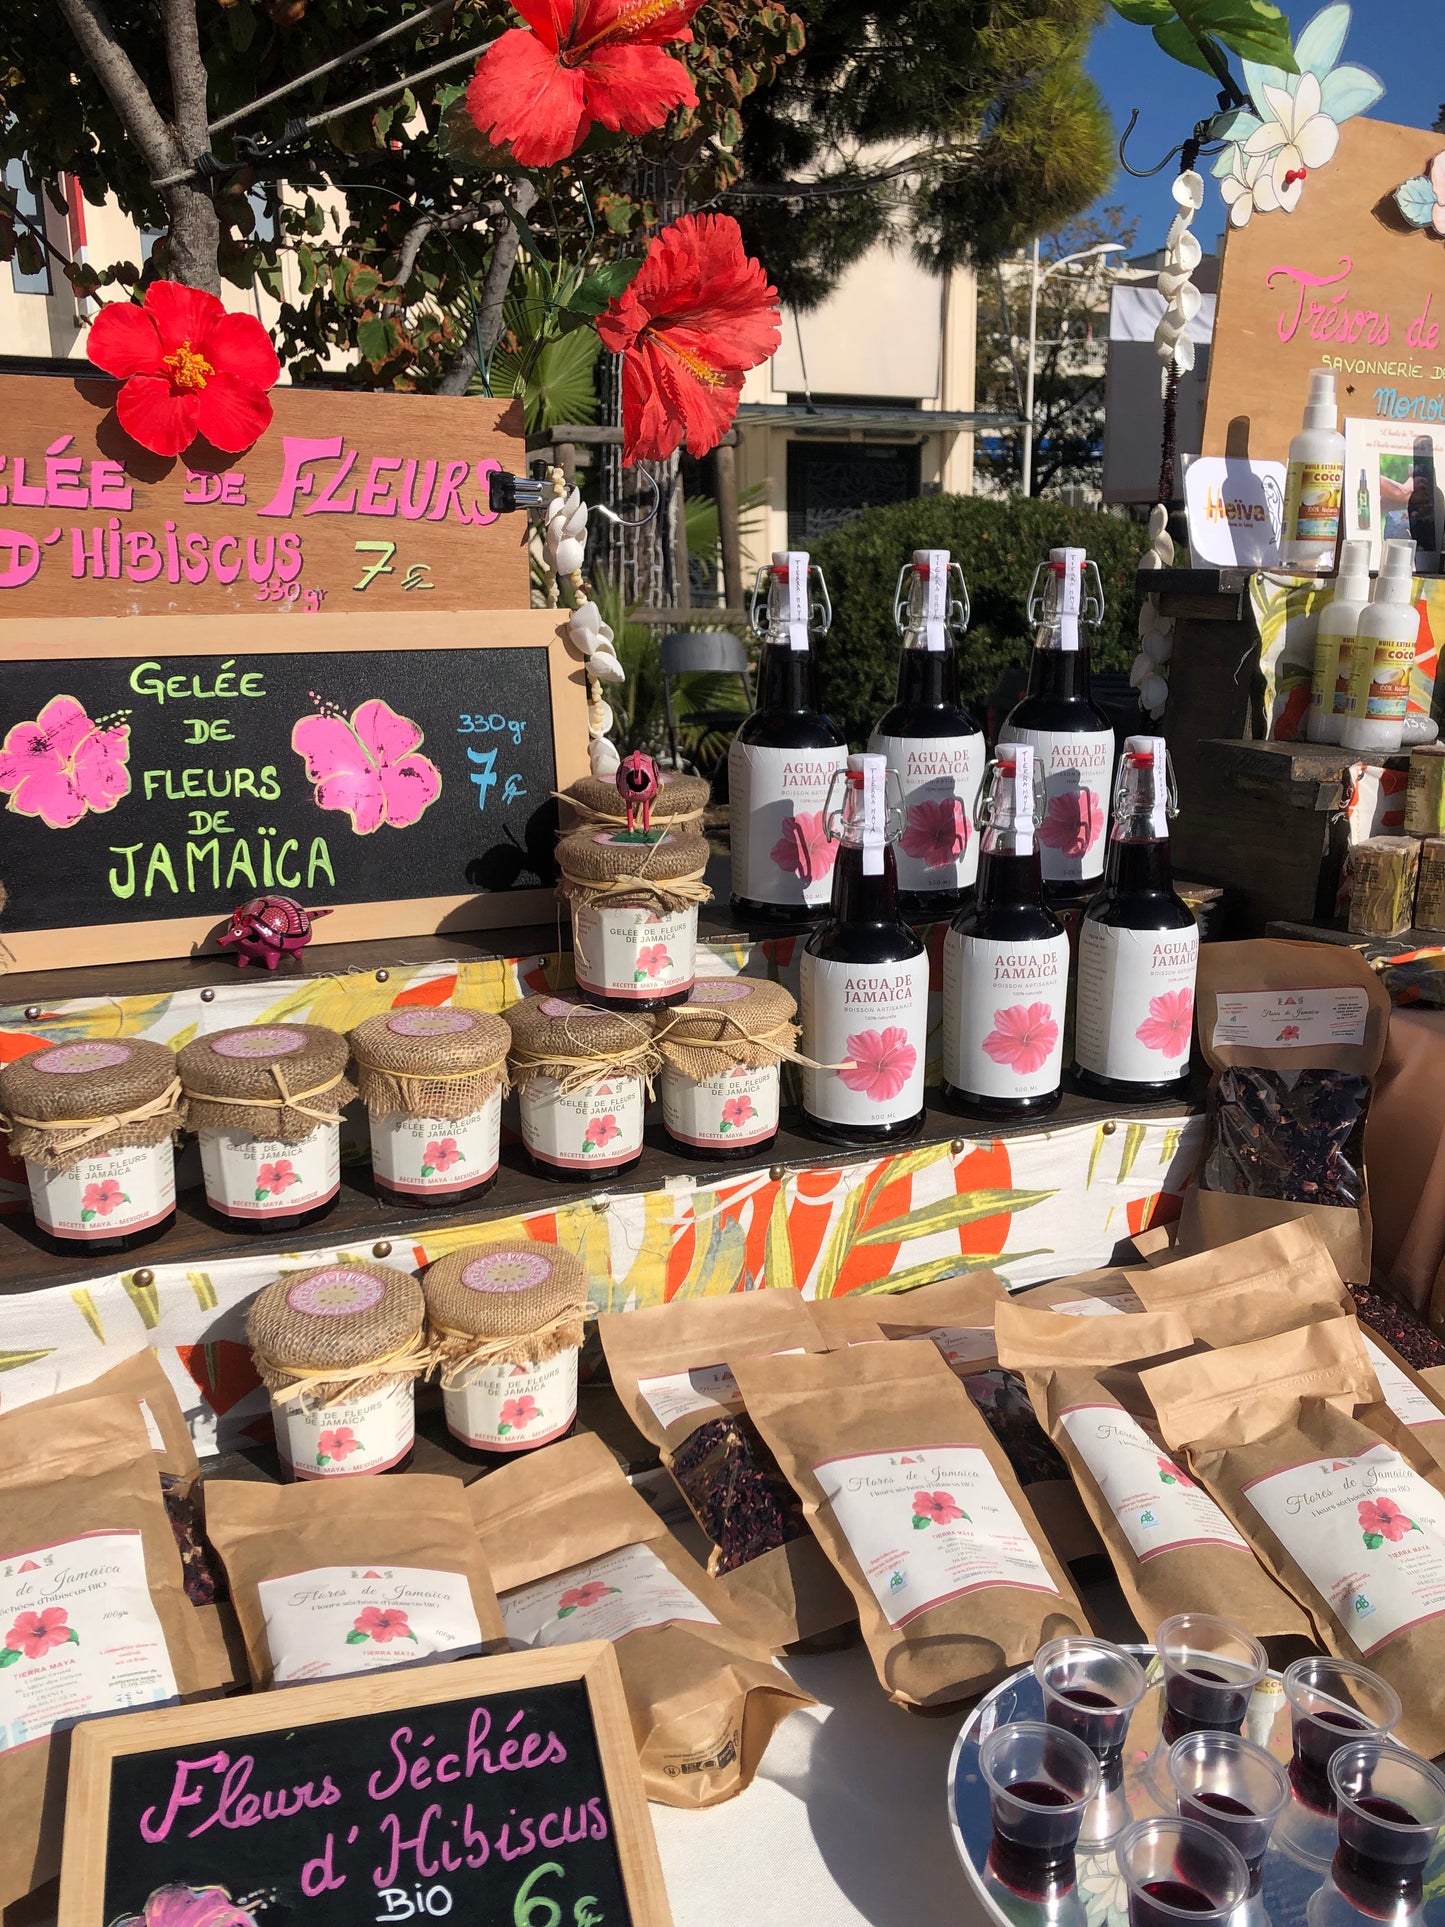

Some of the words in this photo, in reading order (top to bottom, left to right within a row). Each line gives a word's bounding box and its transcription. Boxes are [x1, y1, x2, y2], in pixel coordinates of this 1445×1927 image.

[1266, 256, 1390, 348] Trésors
[1406, 292, 1440, 350] de
[183, 471, 246, 506] DE
[258, 436, 504, 526] FLEURS
[1314, 473, 1341, 482] COCO
[352, 541, 395, 592] 7
[1388, 651, 1414, 660] COCO
[130, 659, 267, 704] GELÉE
[184, 719, 235, 744] DE
[908, 752, 948, 763] AGUA
[954, 750, 970, 762] DE
[1052, 745, 1091, 756] AGUA
[1094, 743, 1107, 754] DE
[784, 763, 823, 774] AGUA
[828, 761, 840, 773] DE
[907, 762, 970, 776] JAMAÏCA
[1050, 754, 1106, 769] JAMAÏCA
[144, 766, 282, 801] FLEURS
[468, 747, 499, 810] 7
[187, 810, 235, 836] DE
[109, 826, 335, 899] JAMAÏCA
[610, 928, 638, 936] GELÉE
[660, 923, 687, 935] FLEURS
[1152, 943, 1188, 955] AGUA
[995, 955, 1038, 967] AGUA
[1043, 952, 1058, 964] DE
[994, 965, 1058, 980] JAMAÏCA
[640, 981, 658, 989] MAYA
[845, 978, 889, 990] AGUA
[895, 974, 912, 986] DE
[1025, 980, 1057, 988] ARTISANALE
[845, 987, 912, 1004] JAMAÏCA
[877, 1002, 913, 1013] ARTISANALE
[696, 1082, 724, 1090] GELÉE
[746, 1074, 770, 1087] FLEURS
[560, 1100, 589, 1108] GELÉE
[611, 1093, 636, 1105] FLEURS
[396, 1122, 425, 1131] GELÉE
[450, 1115, 481, 1129] FLEURS
[110, 1153, 147, 1170] FLEURS
[68, 1172, 81, 1180] DE
[400, 1176, 425, 1185] RECETTE
[233, 1200, 259, 1208] RECETTE
[263, 1200, 283, 1208] MAYA
[58, 1221, 86, 1229] RECETTE
[508, 1381, 521, 1389] DE
[528, 1368, 560, 1386] FLEURS
[345, 1401, 383, 1418] FLEURS
[305, 1418, 318, 1426] DE
[475, 1432, 501, 1441] RECETTE
[504, 1434, 526, 1442] MAYA
[295, 1461, 321, 1472] RECETTE
[847, 1477, 894, 1492] Flores
[906, 1470, 918, 1480] de
[1286, 1488, 1333, 1514] Flores
[1343, 1477, 1357, 1490] de
[1388, 1549, 1412, 1560] TIERRA
[1412, 1544, 1431, 1553] MAYA
[16, 1582, 34, 1597] de
[88, 1582, 107, 1592] BIO
[288, 1588, 347, 1607] Flores
[362, 1585, 377, 1595] de
[14, 1666, 47, 1680] TIERRA
[50, 1658, 76, 1670] MAYA
[139, 1750, 343, 1844] Fleurs
[367, 1708, 568, 1802] Séchées
[373, 1795, 610, 1889] Hibiscus
[512, 1860, 565, 1927] 6
